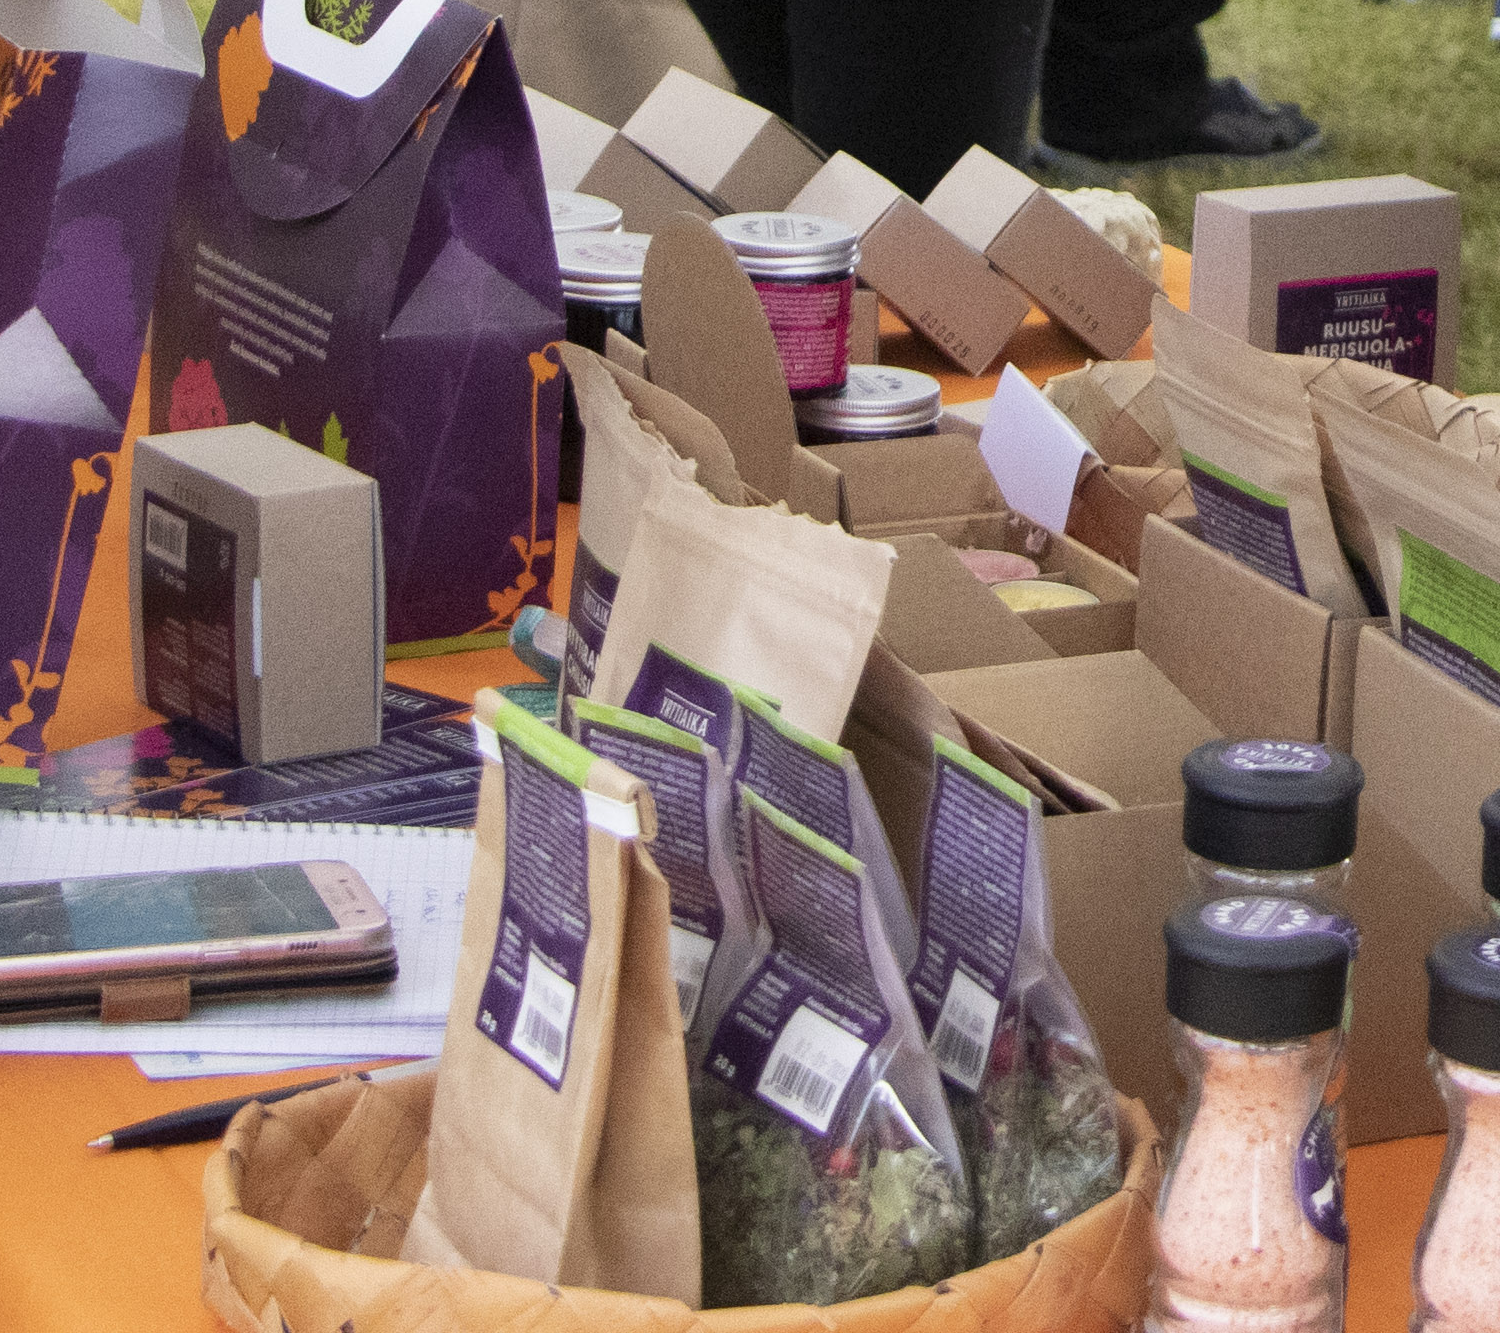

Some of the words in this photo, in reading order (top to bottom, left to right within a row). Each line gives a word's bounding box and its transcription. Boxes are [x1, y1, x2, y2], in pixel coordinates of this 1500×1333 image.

[1335, 291, 1387, 308] YRTTIAIKA
[1323, 318, 1395, 338] RUUSU-
[1304, 337, 1413, 359] MERISUOLA-
[660, 696, 710, 738] YRTTIAIKA
